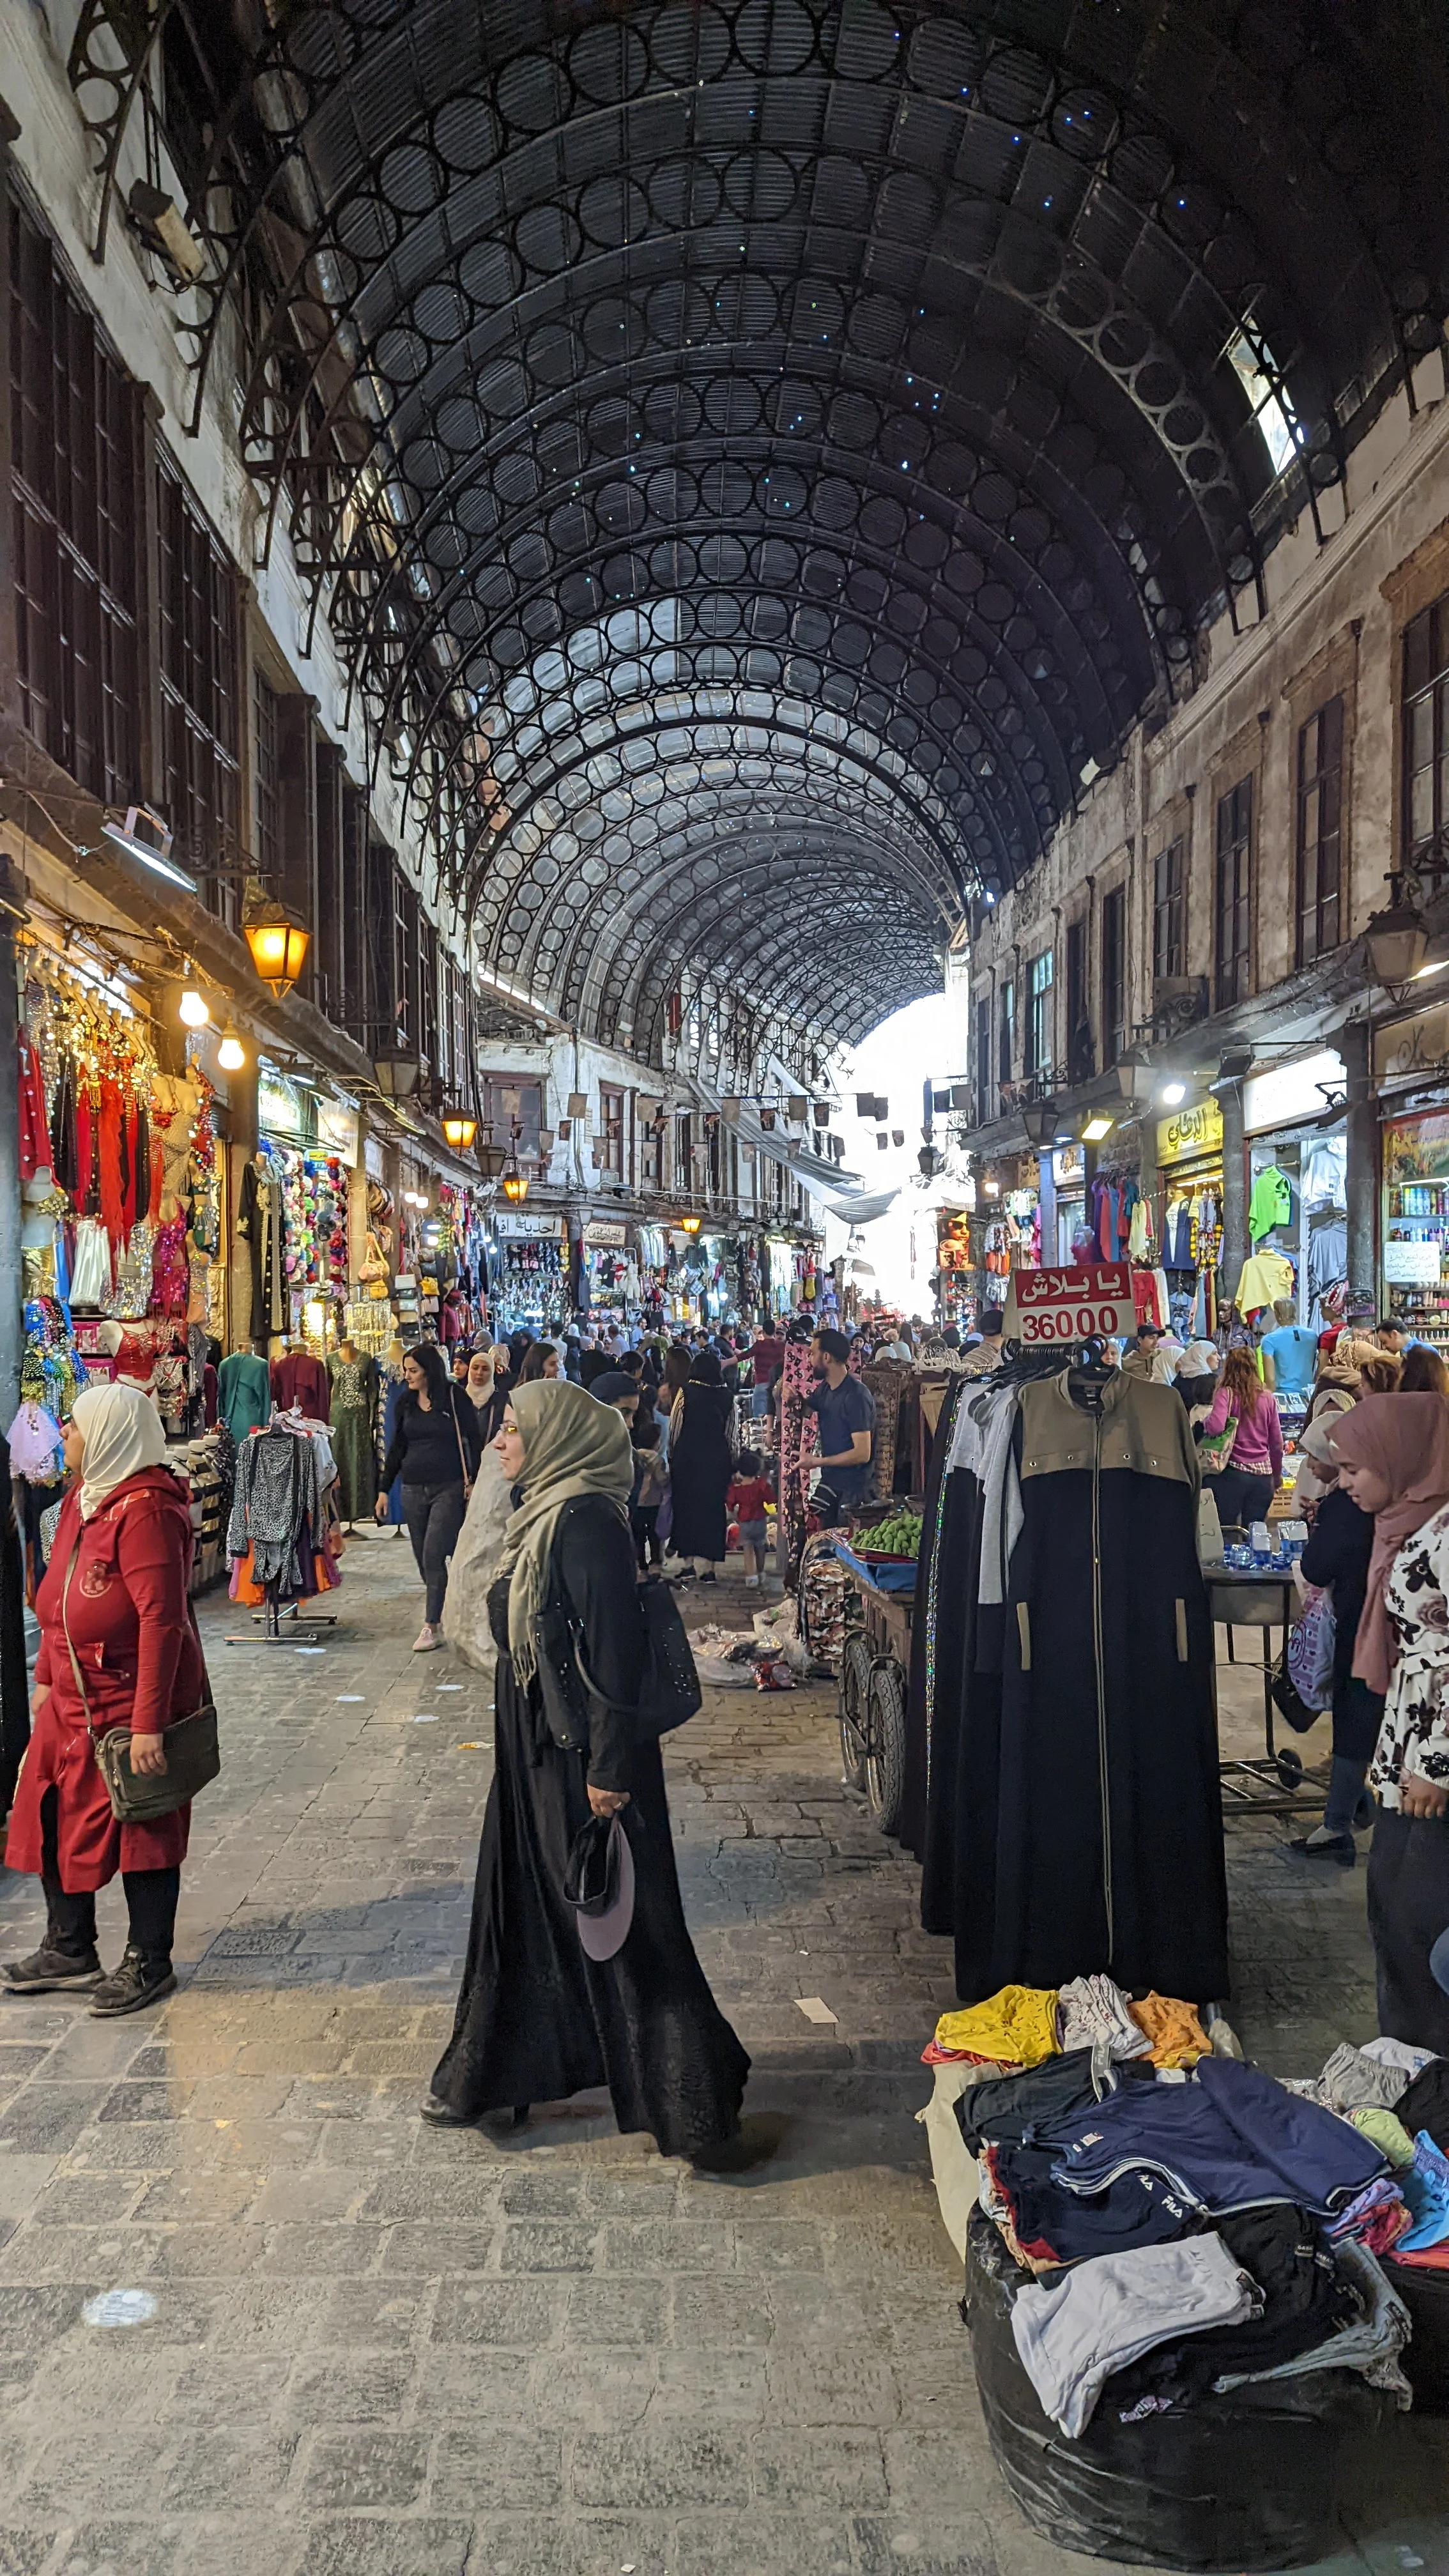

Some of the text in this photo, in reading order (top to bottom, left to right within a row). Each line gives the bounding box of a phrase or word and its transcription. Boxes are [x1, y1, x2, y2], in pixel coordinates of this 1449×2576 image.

[1022, 1270, 1124, 1303] يا بلاش
[1022, 1305, 1118, 1341] 36000
[1161, 2195, 1183, 2218] FILA
